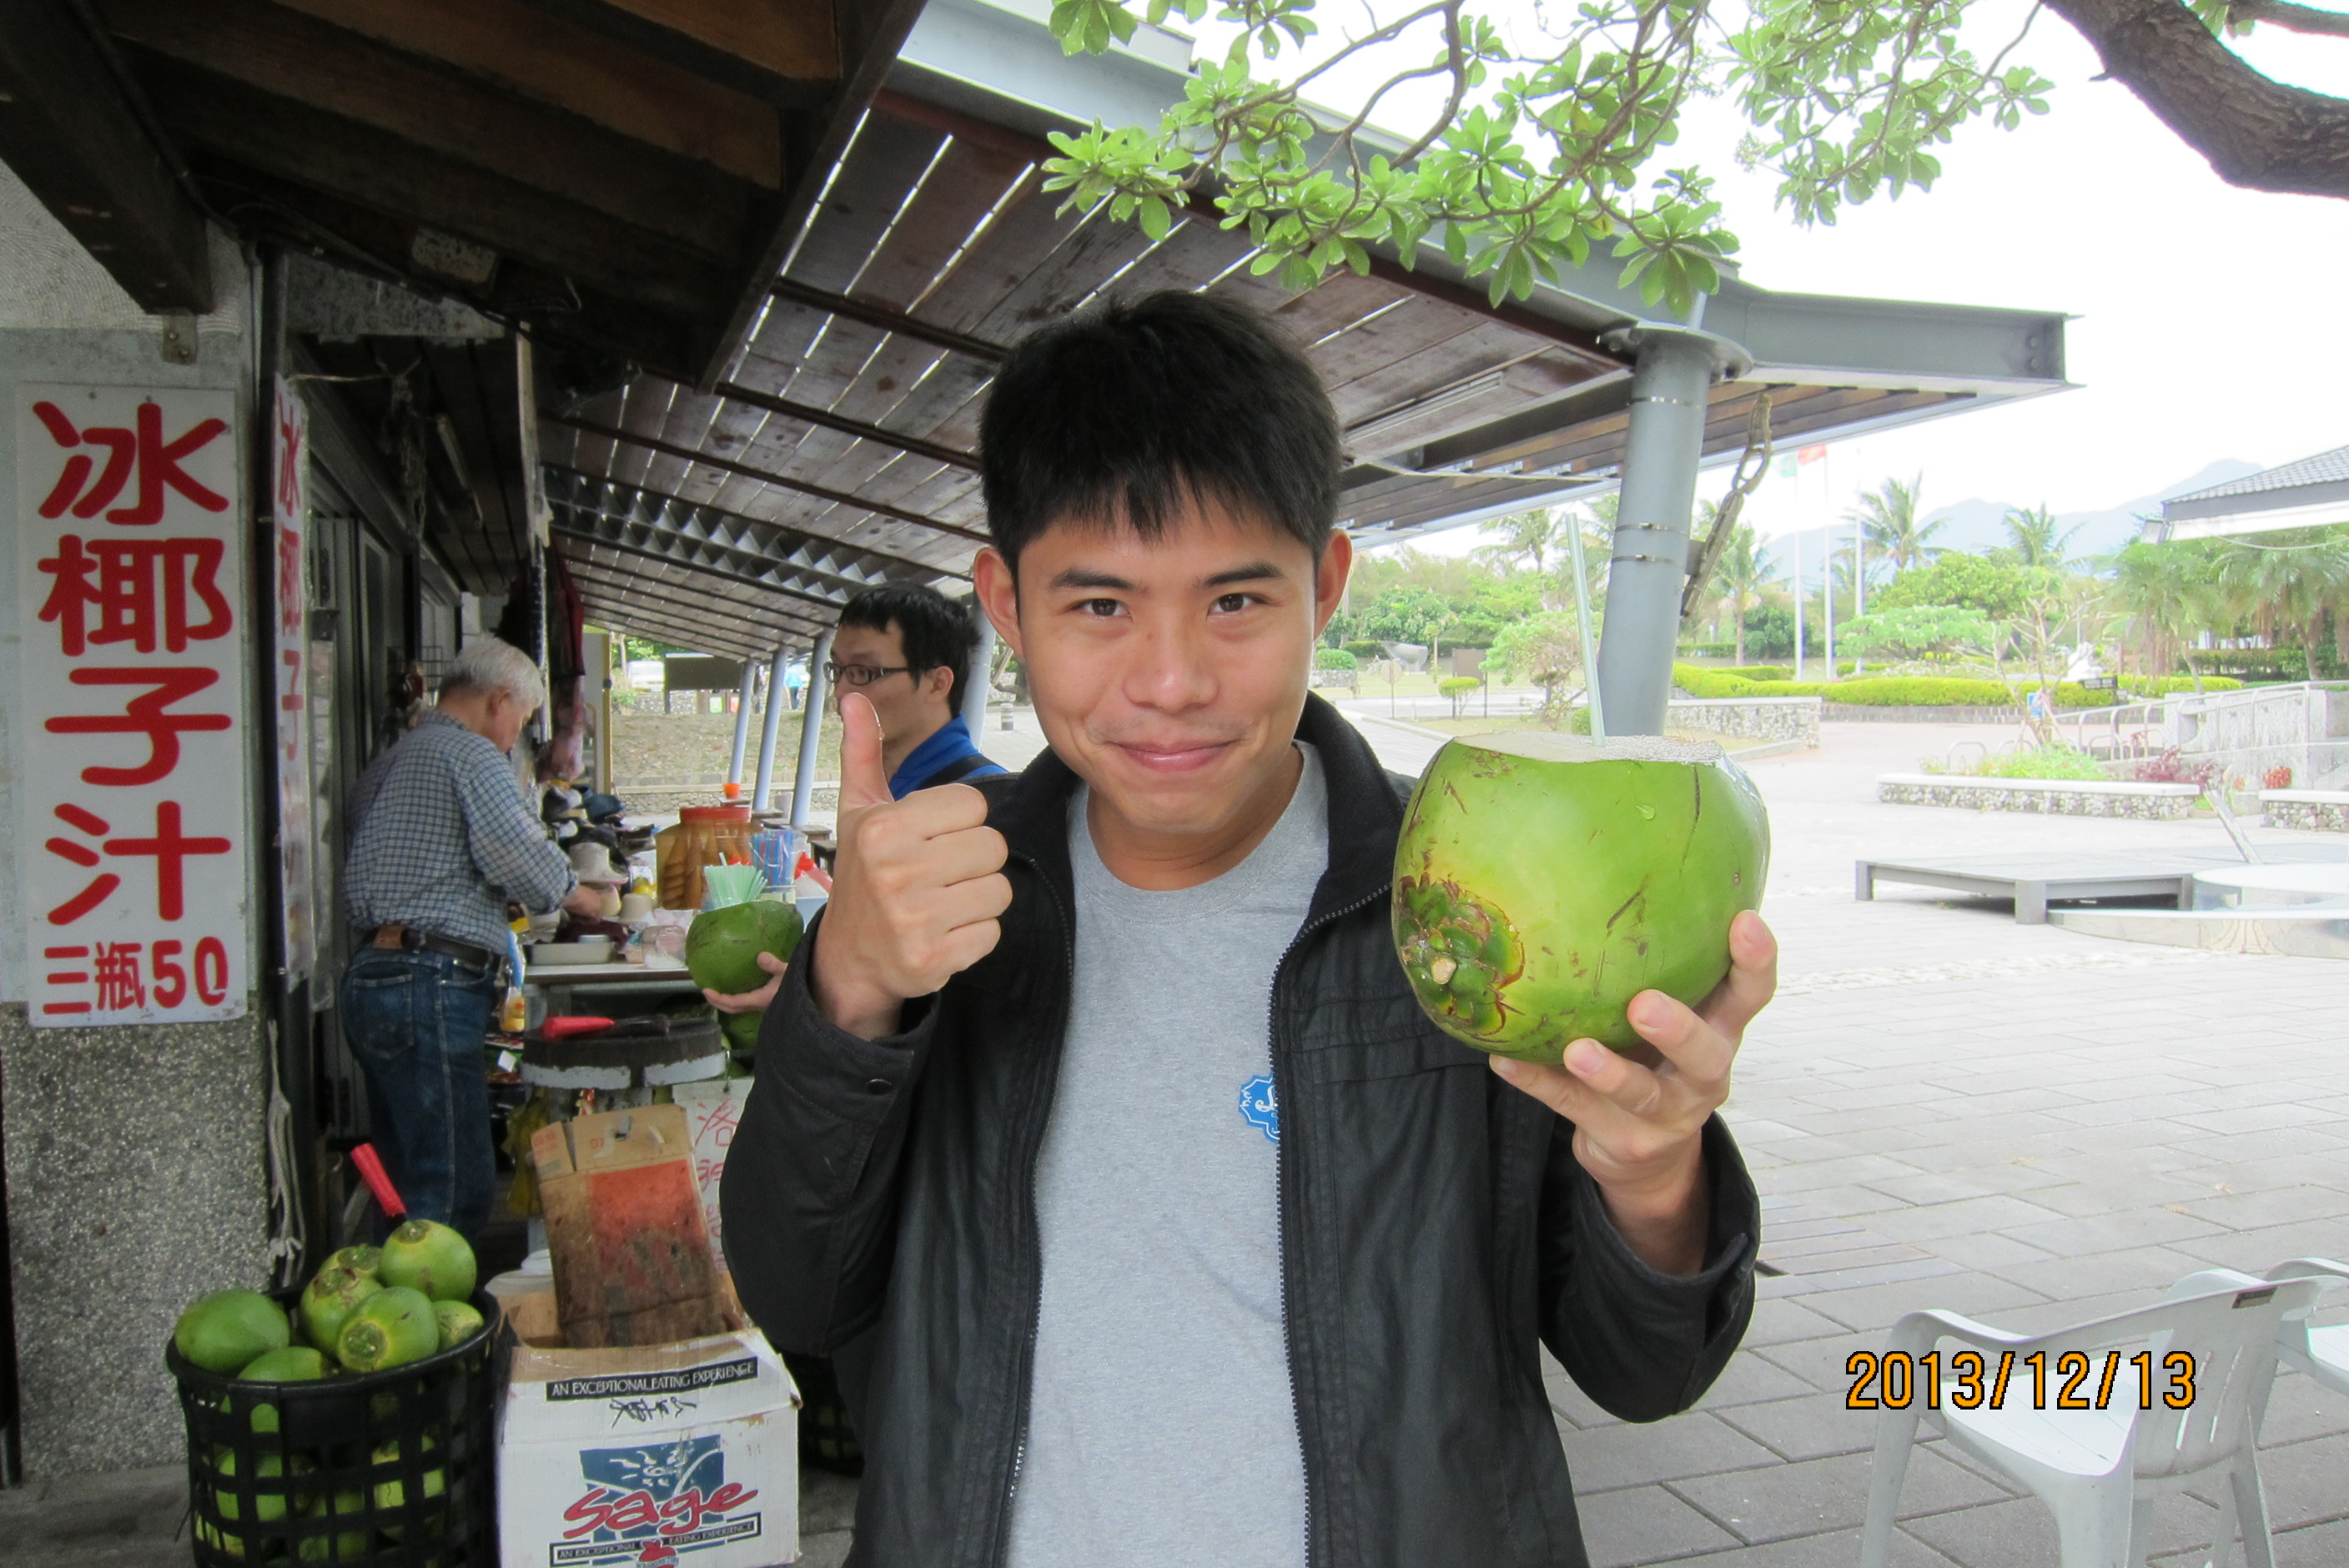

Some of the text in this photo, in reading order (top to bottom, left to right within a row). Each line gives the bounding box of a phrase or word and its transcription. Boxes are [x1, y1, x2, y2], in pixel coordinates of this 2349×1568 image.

[34, 401, 233, 926] 冰椰子汁
[43, 936, 229, 1015] 三瓶50
[551, 1362, 754, 1396] AN EXCEPTIONAL EATING EXPERIENCE
[559, 1522, 752, 1559] AN EXCEPTIONAL EATING EXPERIENCE
